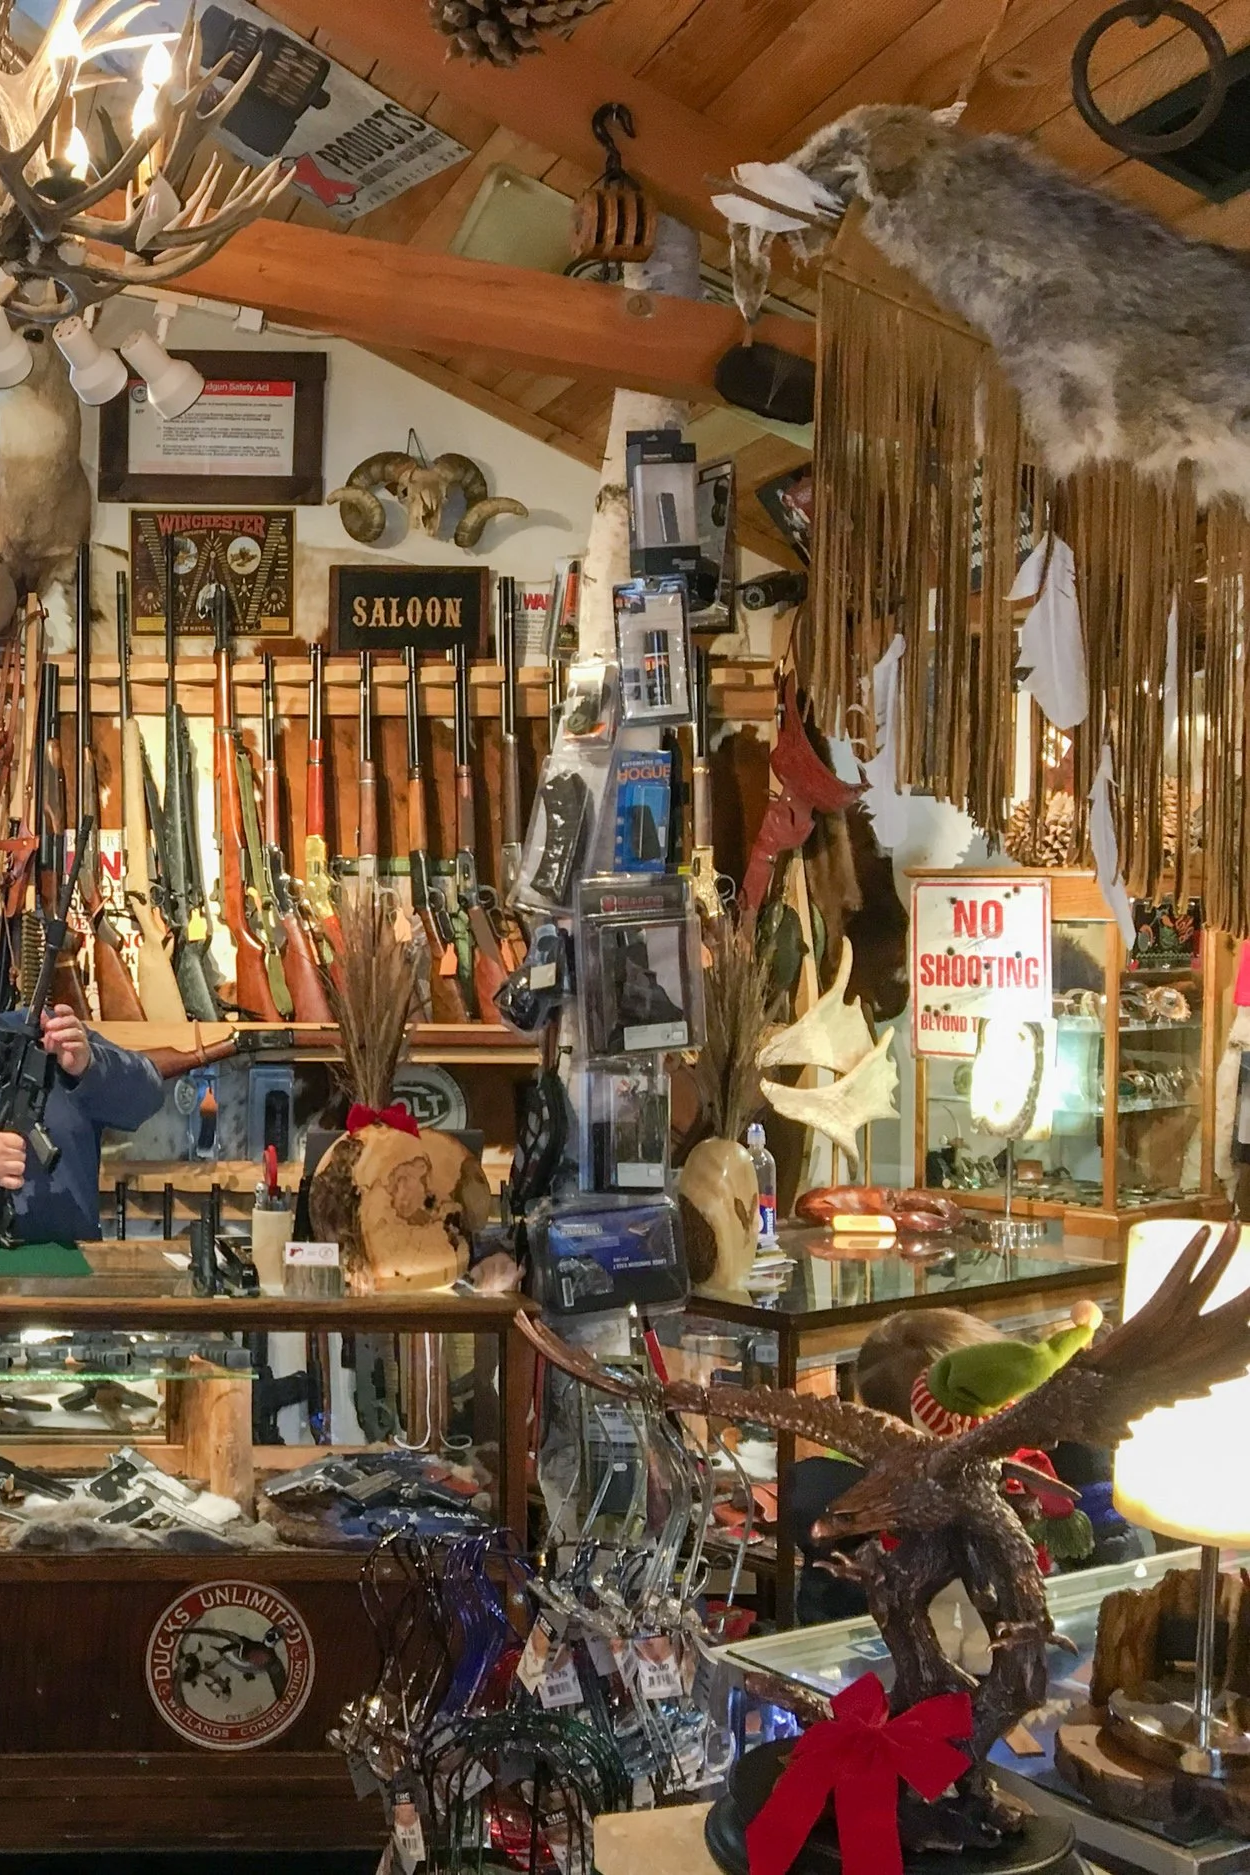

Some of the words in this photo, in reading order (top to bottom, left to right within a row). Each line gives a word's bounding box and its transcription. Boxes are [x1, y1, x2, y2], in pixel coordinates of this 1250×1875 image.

[316, 103, 427, 175] PRODUCTS
[230, 381, 255, 392] Safety
[256, 382, 270, 391] Act
[156, 514, 266, 538] WINCHESTER
[352, 596, 463, 628] SALOON
[953, 900, 1005, 939] NO
[920, 954, 1040, 989] SHOOTING
[921, 1014, 968, 1034] BEYOND
[391, 1095, 443, 1118] OLT
[153, 1607, 191, 1681] DUCKS
[199, 1587, 302, 1644] UNLIMITED
[167, 1696, 230, 1738] WETLANDS
[240, 1660, 303, 1736] CONSERVATION
